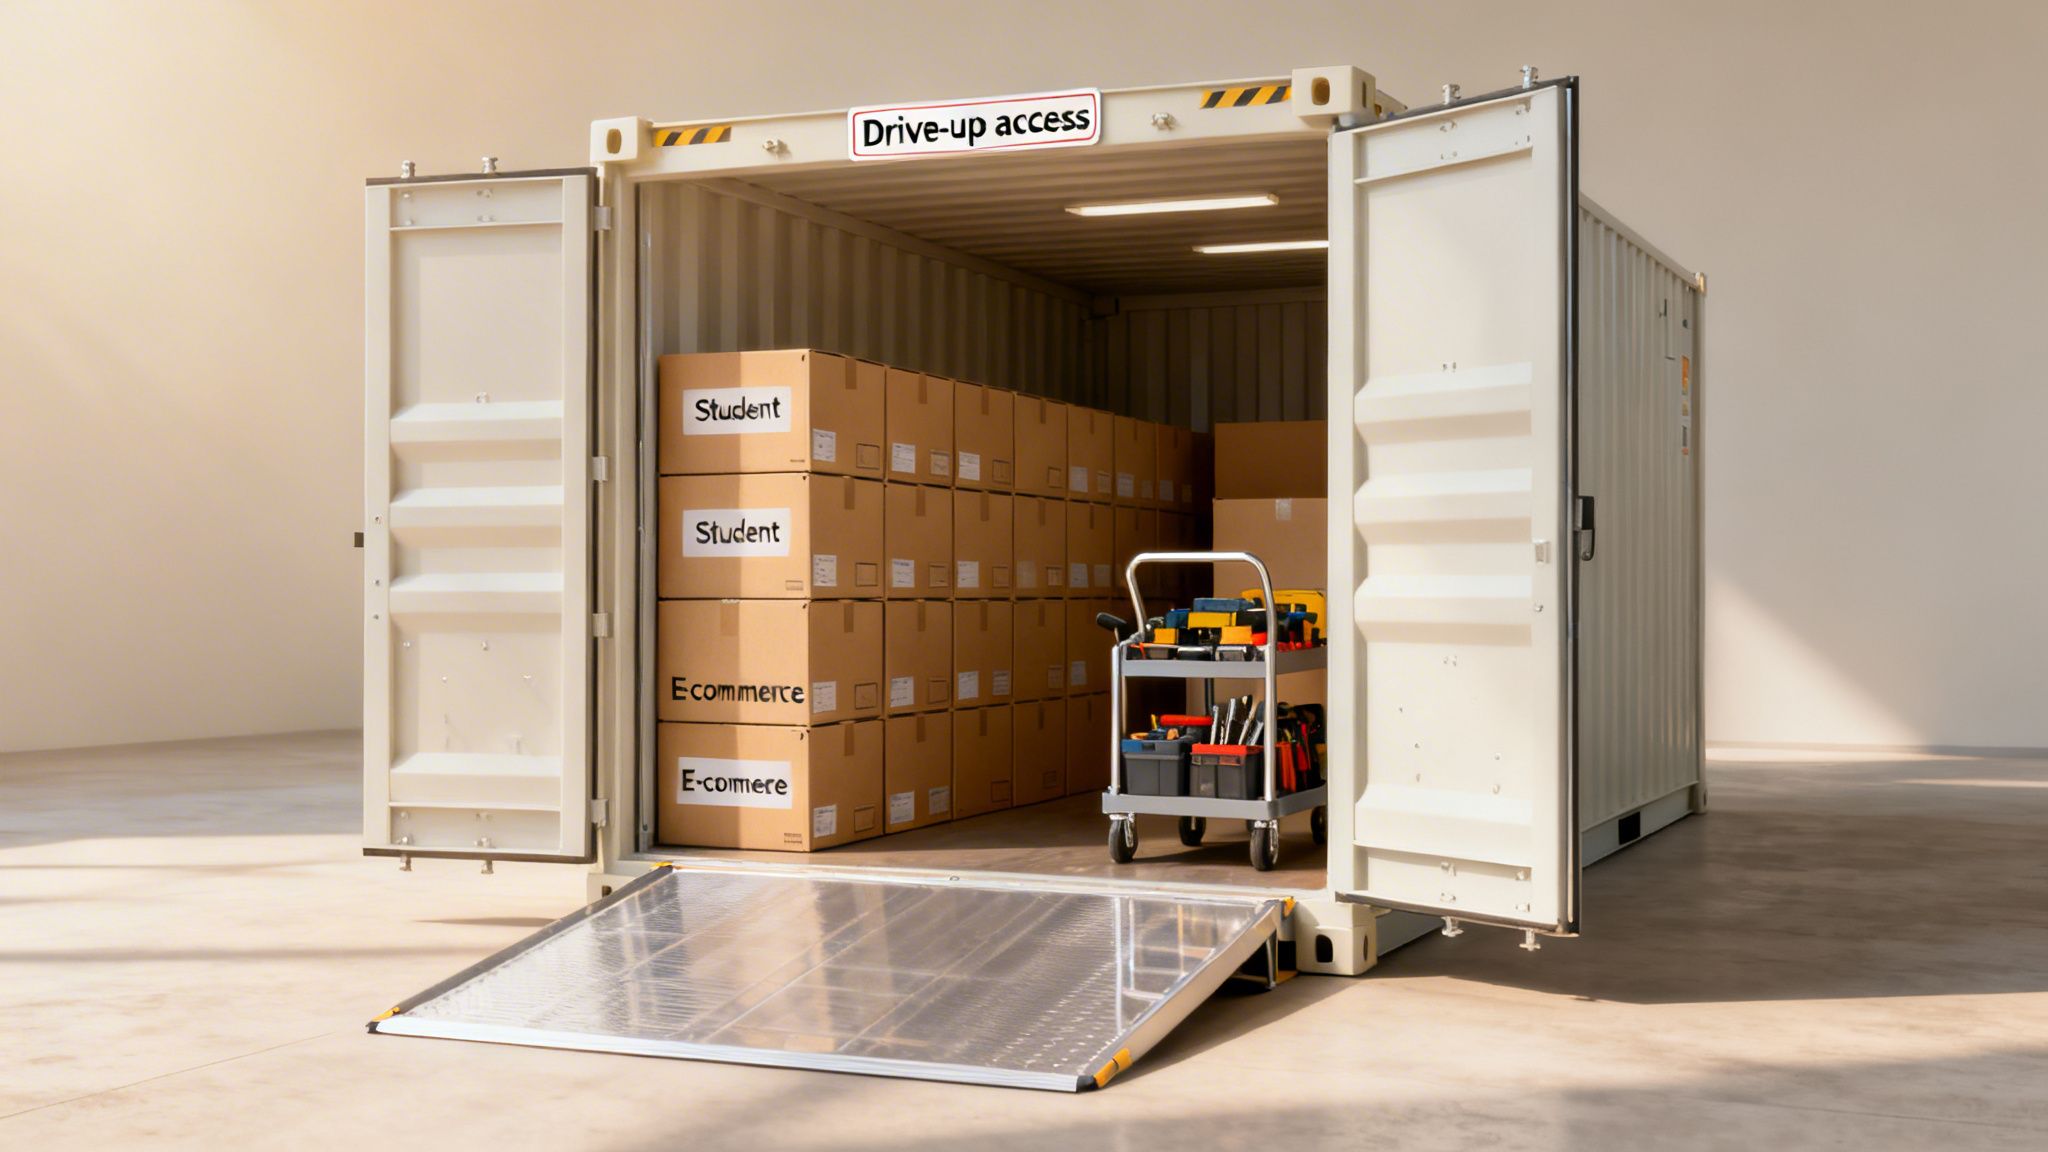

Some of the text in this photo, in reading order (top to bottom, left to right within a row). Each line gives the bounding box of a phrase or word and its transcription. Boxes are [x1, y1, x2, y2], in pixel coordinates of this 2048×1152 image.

[863, 108, 1090, 147] Drive-up access
[695, 396, 781, 422] Student
[696, 518, 780, 545] Student
